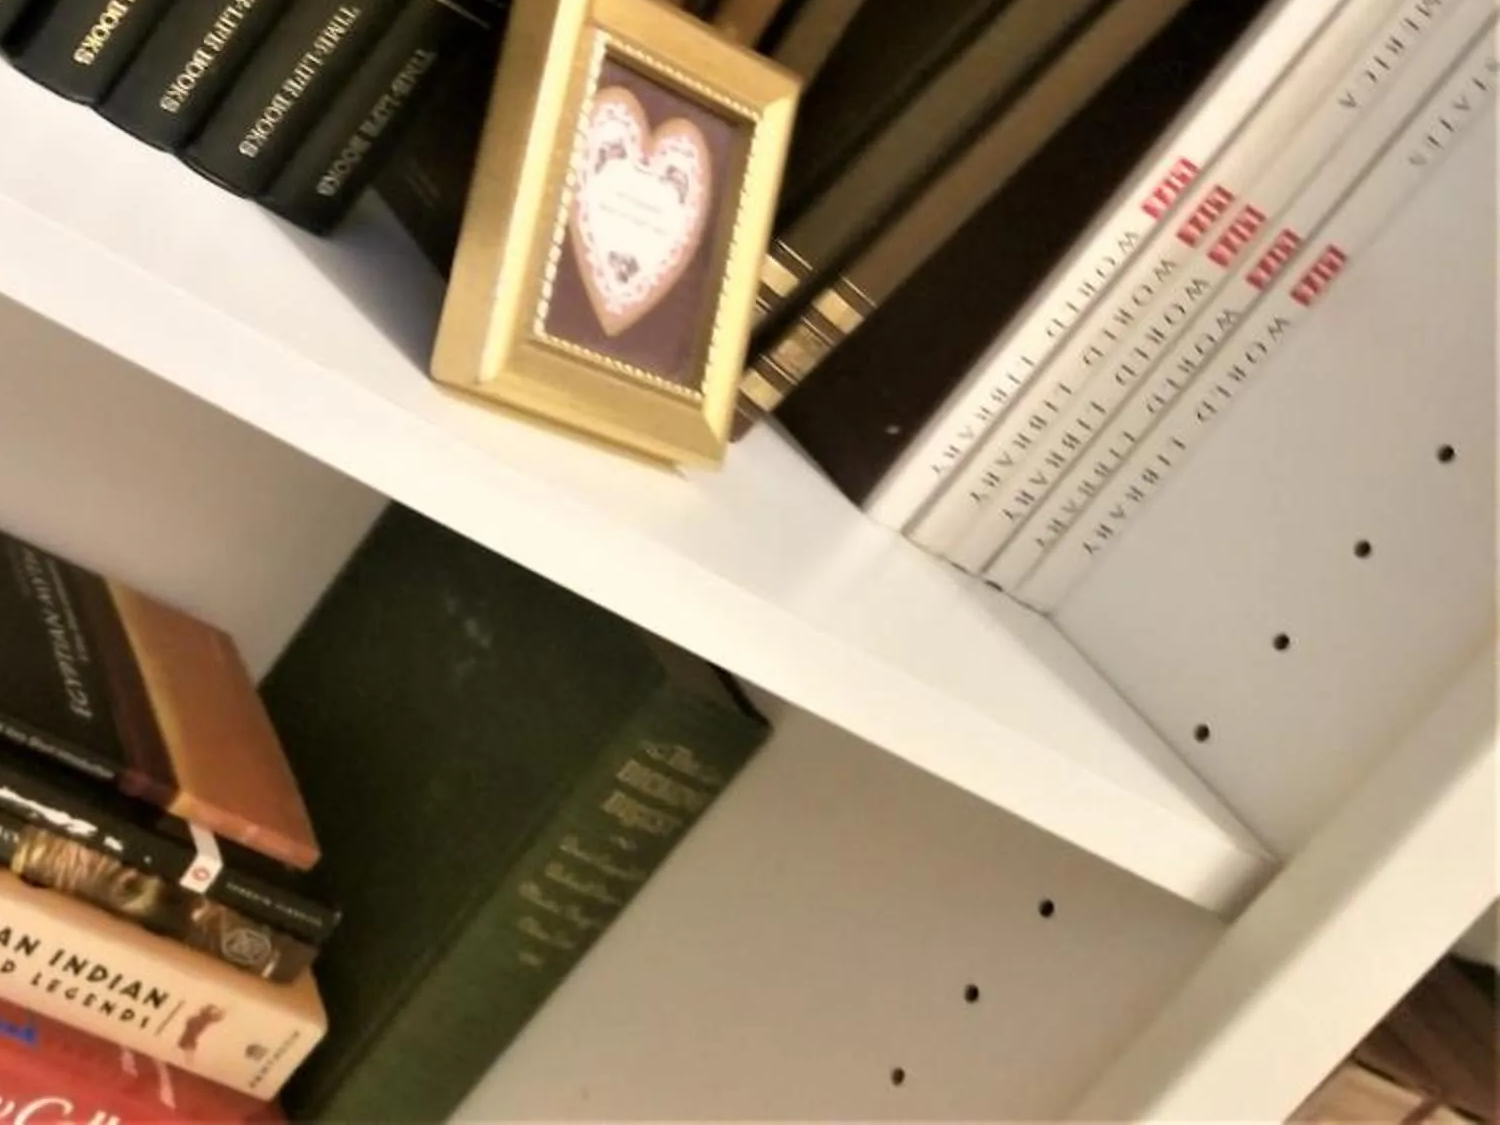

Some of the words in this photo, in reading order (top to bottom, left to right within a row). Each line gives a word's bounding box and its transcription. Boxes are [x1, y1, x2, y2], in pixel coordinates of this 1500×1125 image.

[156, 45, 214, 115] BOOKS
[236, 91, 294, 160] BOOKS
[312, 132, 373, 201] BOOKS
[1042, 226, 1141, 342] WORLD
[1077, 254, 1176, 368] WORLD
[1109, 273, 1211, 388] WORLD
[926, 354, 1036, 479] LIBRARY
[1140, 303, 1241, 418] WORLD
[1191, 313, 1292, 427] WORLD
[963, 381, 1074, 508] LIBRARY
[997, 400, 1108, 526] LIBRARY
[1031, 430, 1139, 552] LIBRARY
[1078, 436, 1187, 559] LIBRARY
[41, 607, 94, 723] EGYPTIAN
[28, 969, 154, 1034] LEGENDS
[46, 945, 171, 1014] INDIAN
